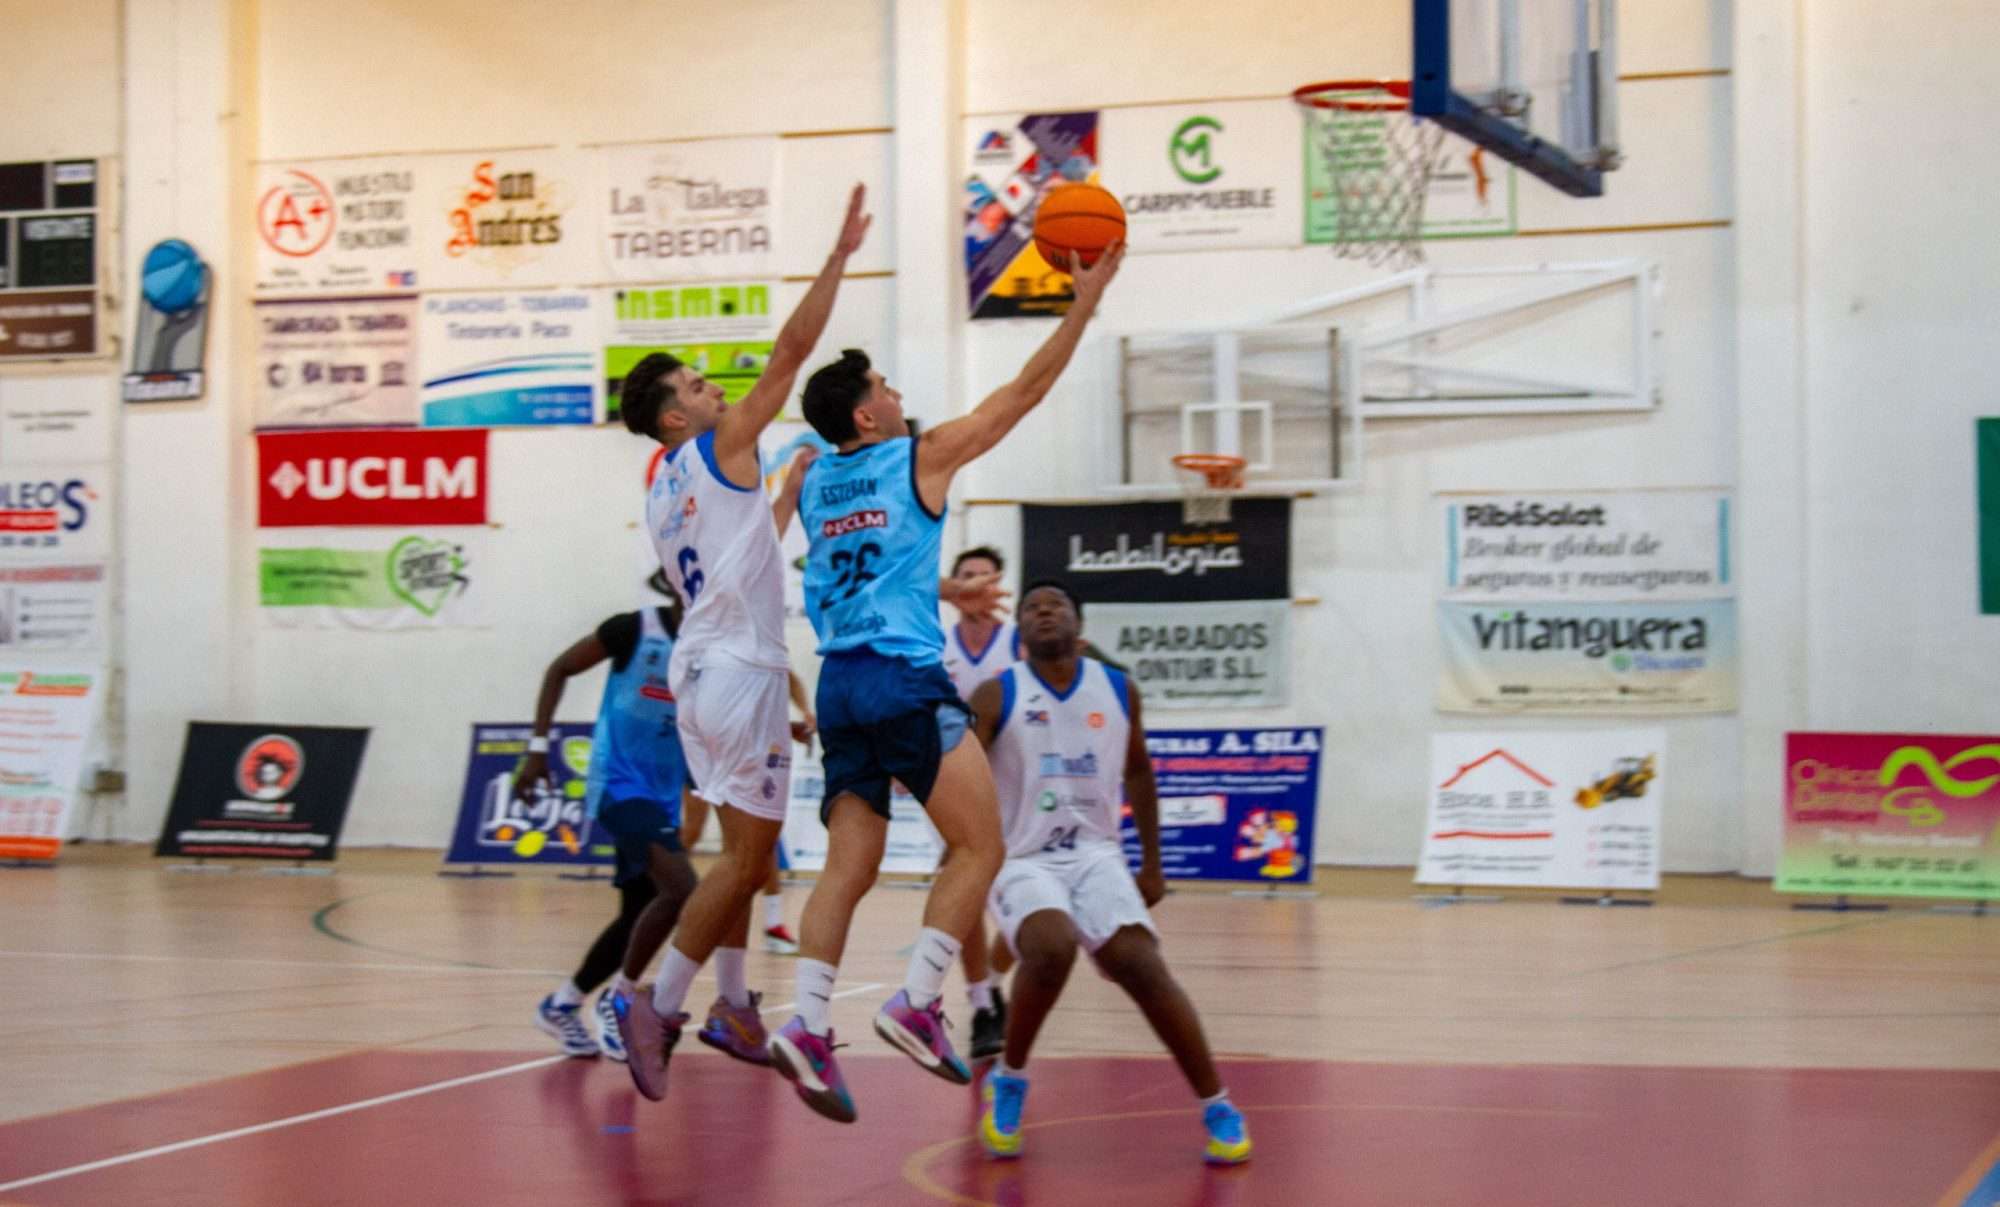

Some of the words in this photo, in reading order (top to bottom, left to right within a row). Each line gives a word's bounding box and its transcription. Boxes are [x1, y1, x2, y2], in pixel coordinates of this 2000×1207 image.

[465, 161, 534, 208] San
[272, 194, 328, 241] A+
[610, 189, 645, 215] La
[446, 203, 563, 258] Andrés
[609, 224, 771, 260] TABERNA
[305, 456, 479, 501] UCLM
[820, 477, 877, 506] ESTEBAN
[833, 512, 886, 533] UCLM
[1550, 532, 1627, 562] global
[1630, 532, 1661, 555] de
[677, 546, 705, 602] 6
[819, 541, 883, 611] 26
[1117, 622, 1269, 653] APARADOS
[1135, 656, 1220, 683] ONTUR
[1253, 729, 1322, 754] SILA
[1041, 826, 1080, 852] 24
